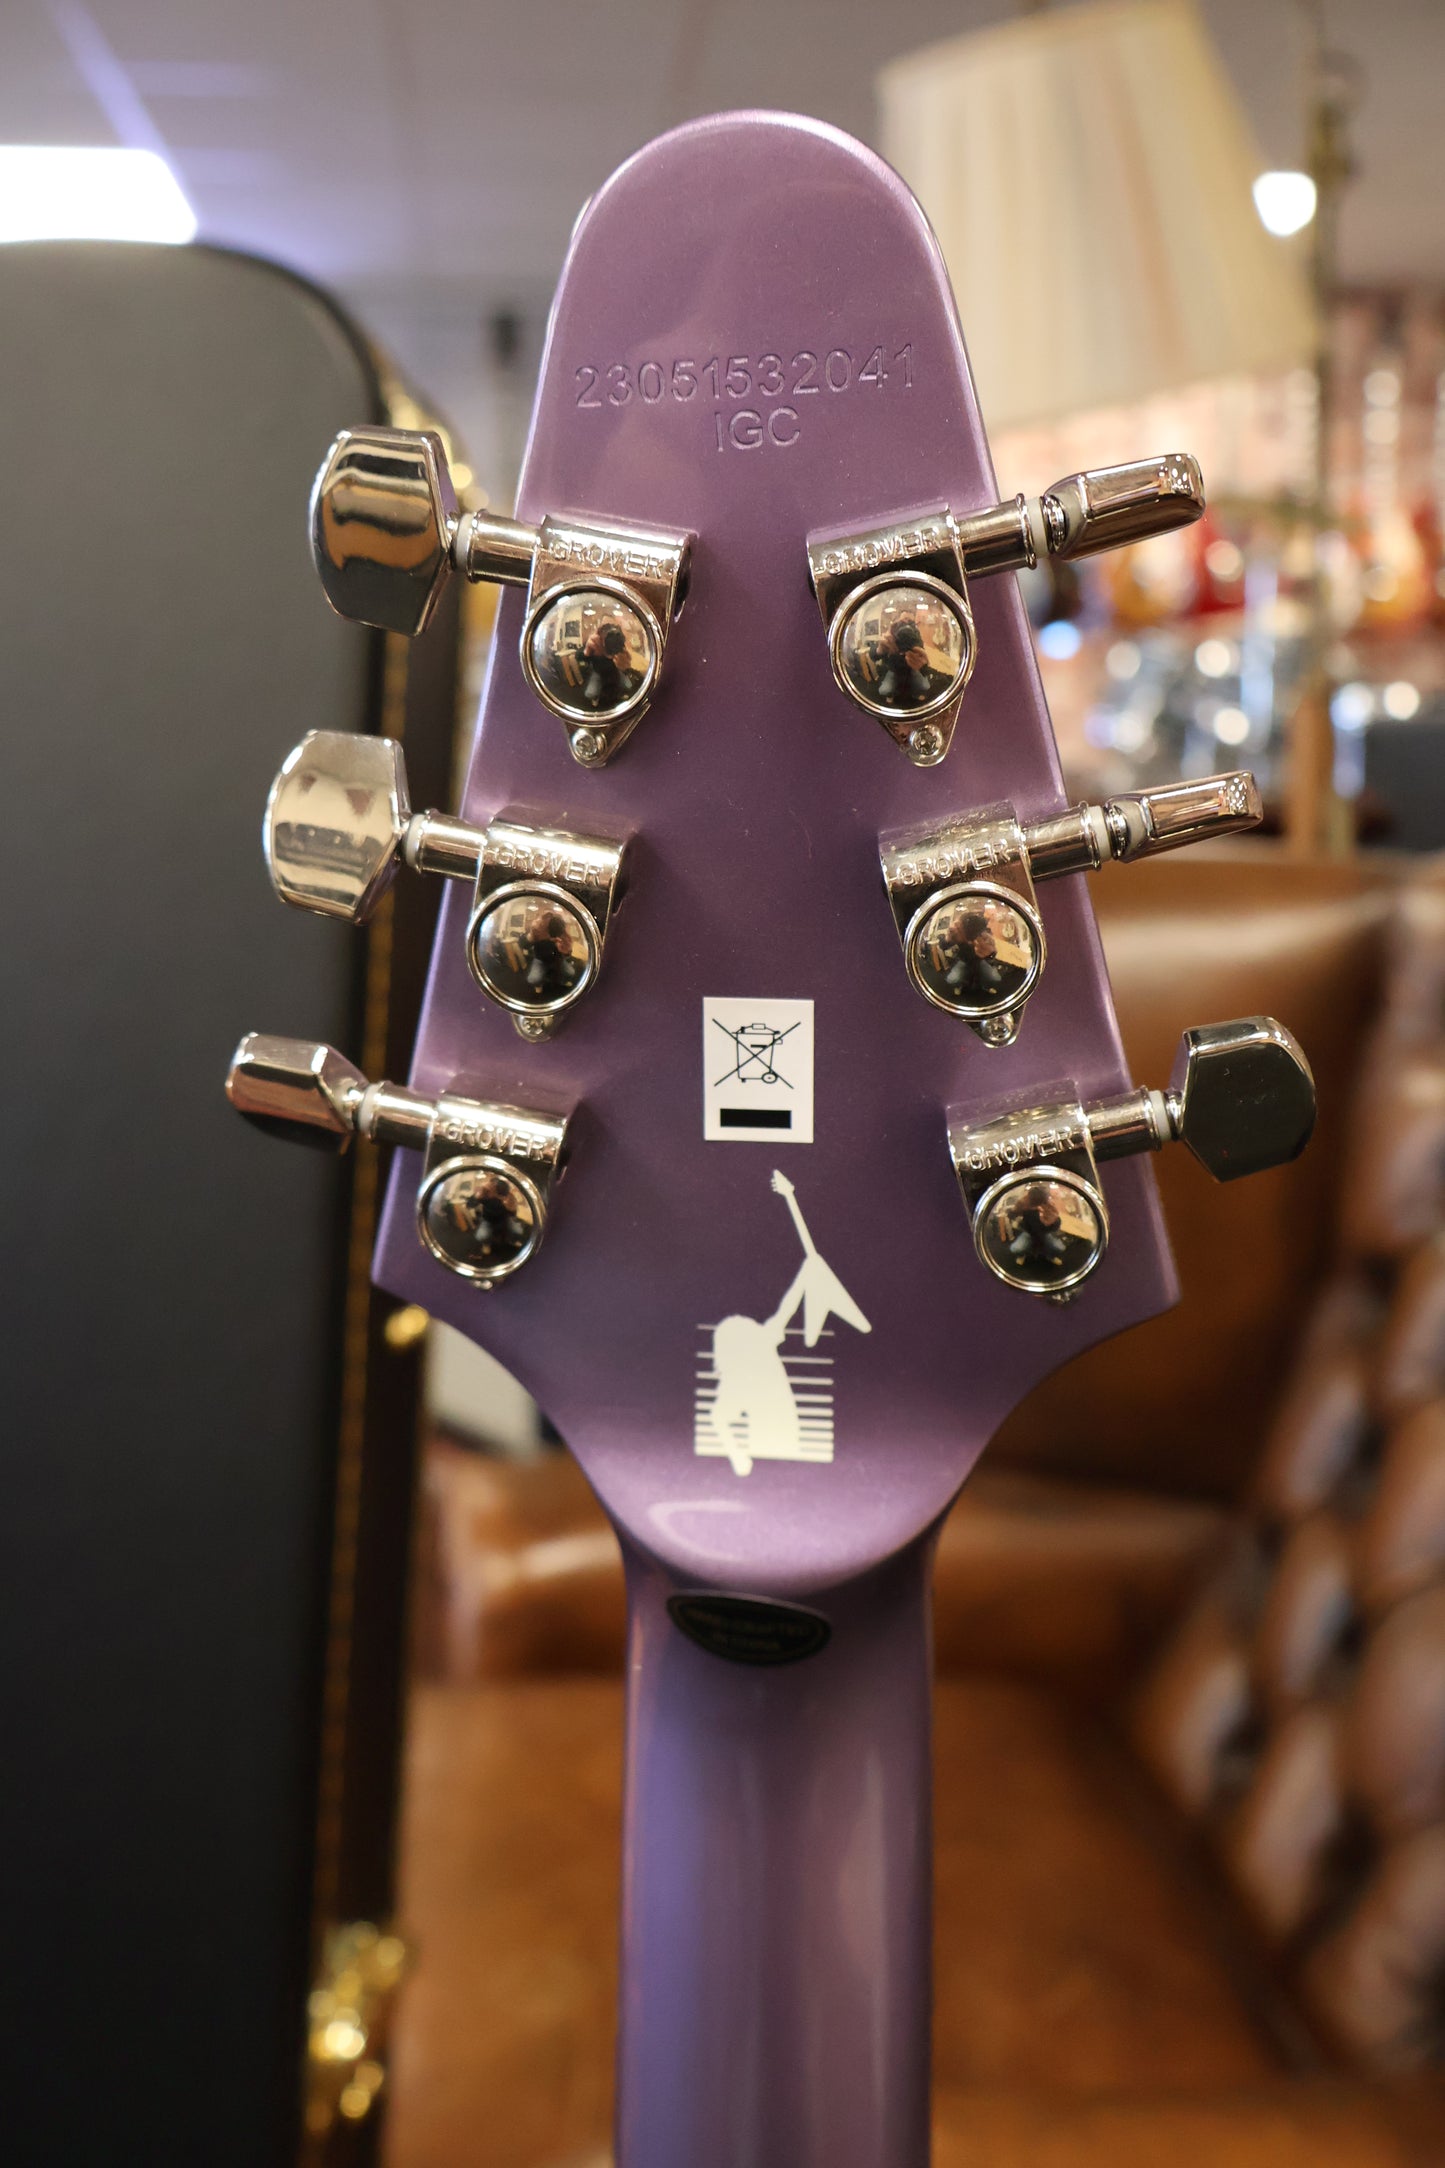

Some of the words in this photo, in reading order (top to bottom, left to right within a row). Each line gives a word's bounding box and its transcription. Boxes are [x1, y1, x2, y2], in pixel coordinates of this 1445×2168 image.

[575, 343, 913, 408] 23051532041
[713, 405, 801, 452] IGC
[550, 538, 663, 579] GROVER
[824, 526, 941, 576] GROVER
[496, 841, 604, 887] GROVER
[896, 838, 1011, 887] GROVER
[444, 1117, 547, 1161] GROVER
[965, 1126, 1076, 1171] GROVER
